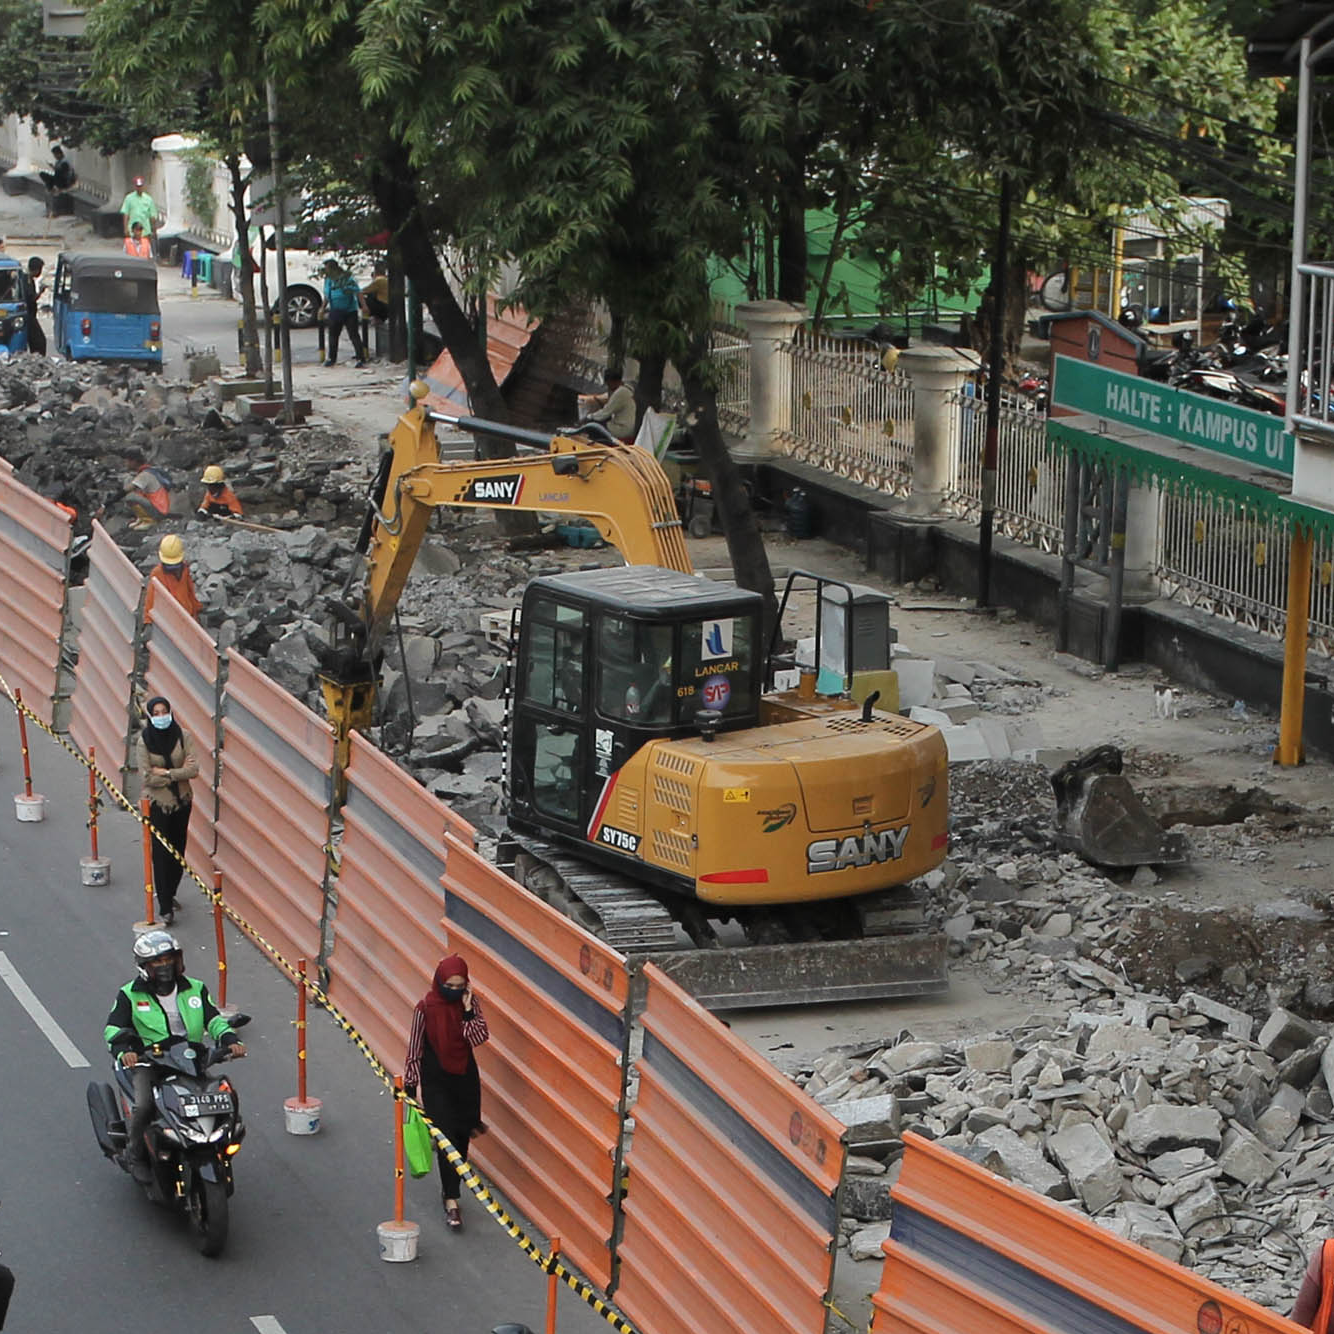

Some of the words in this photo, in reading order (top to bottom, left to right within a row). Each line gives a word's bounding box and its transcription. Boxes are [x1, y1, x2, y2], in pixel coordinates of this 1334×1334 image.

[1107, 382, 1162, 424] HALTE
[1178, 402, 1258, 452] KAMPUS
[474, 481, 515, 498] SANY
[694, 661, 739, 678] LANCAR
[602, 827, 637, 852] SY75C
[806, 824, 911, 875] SANY
